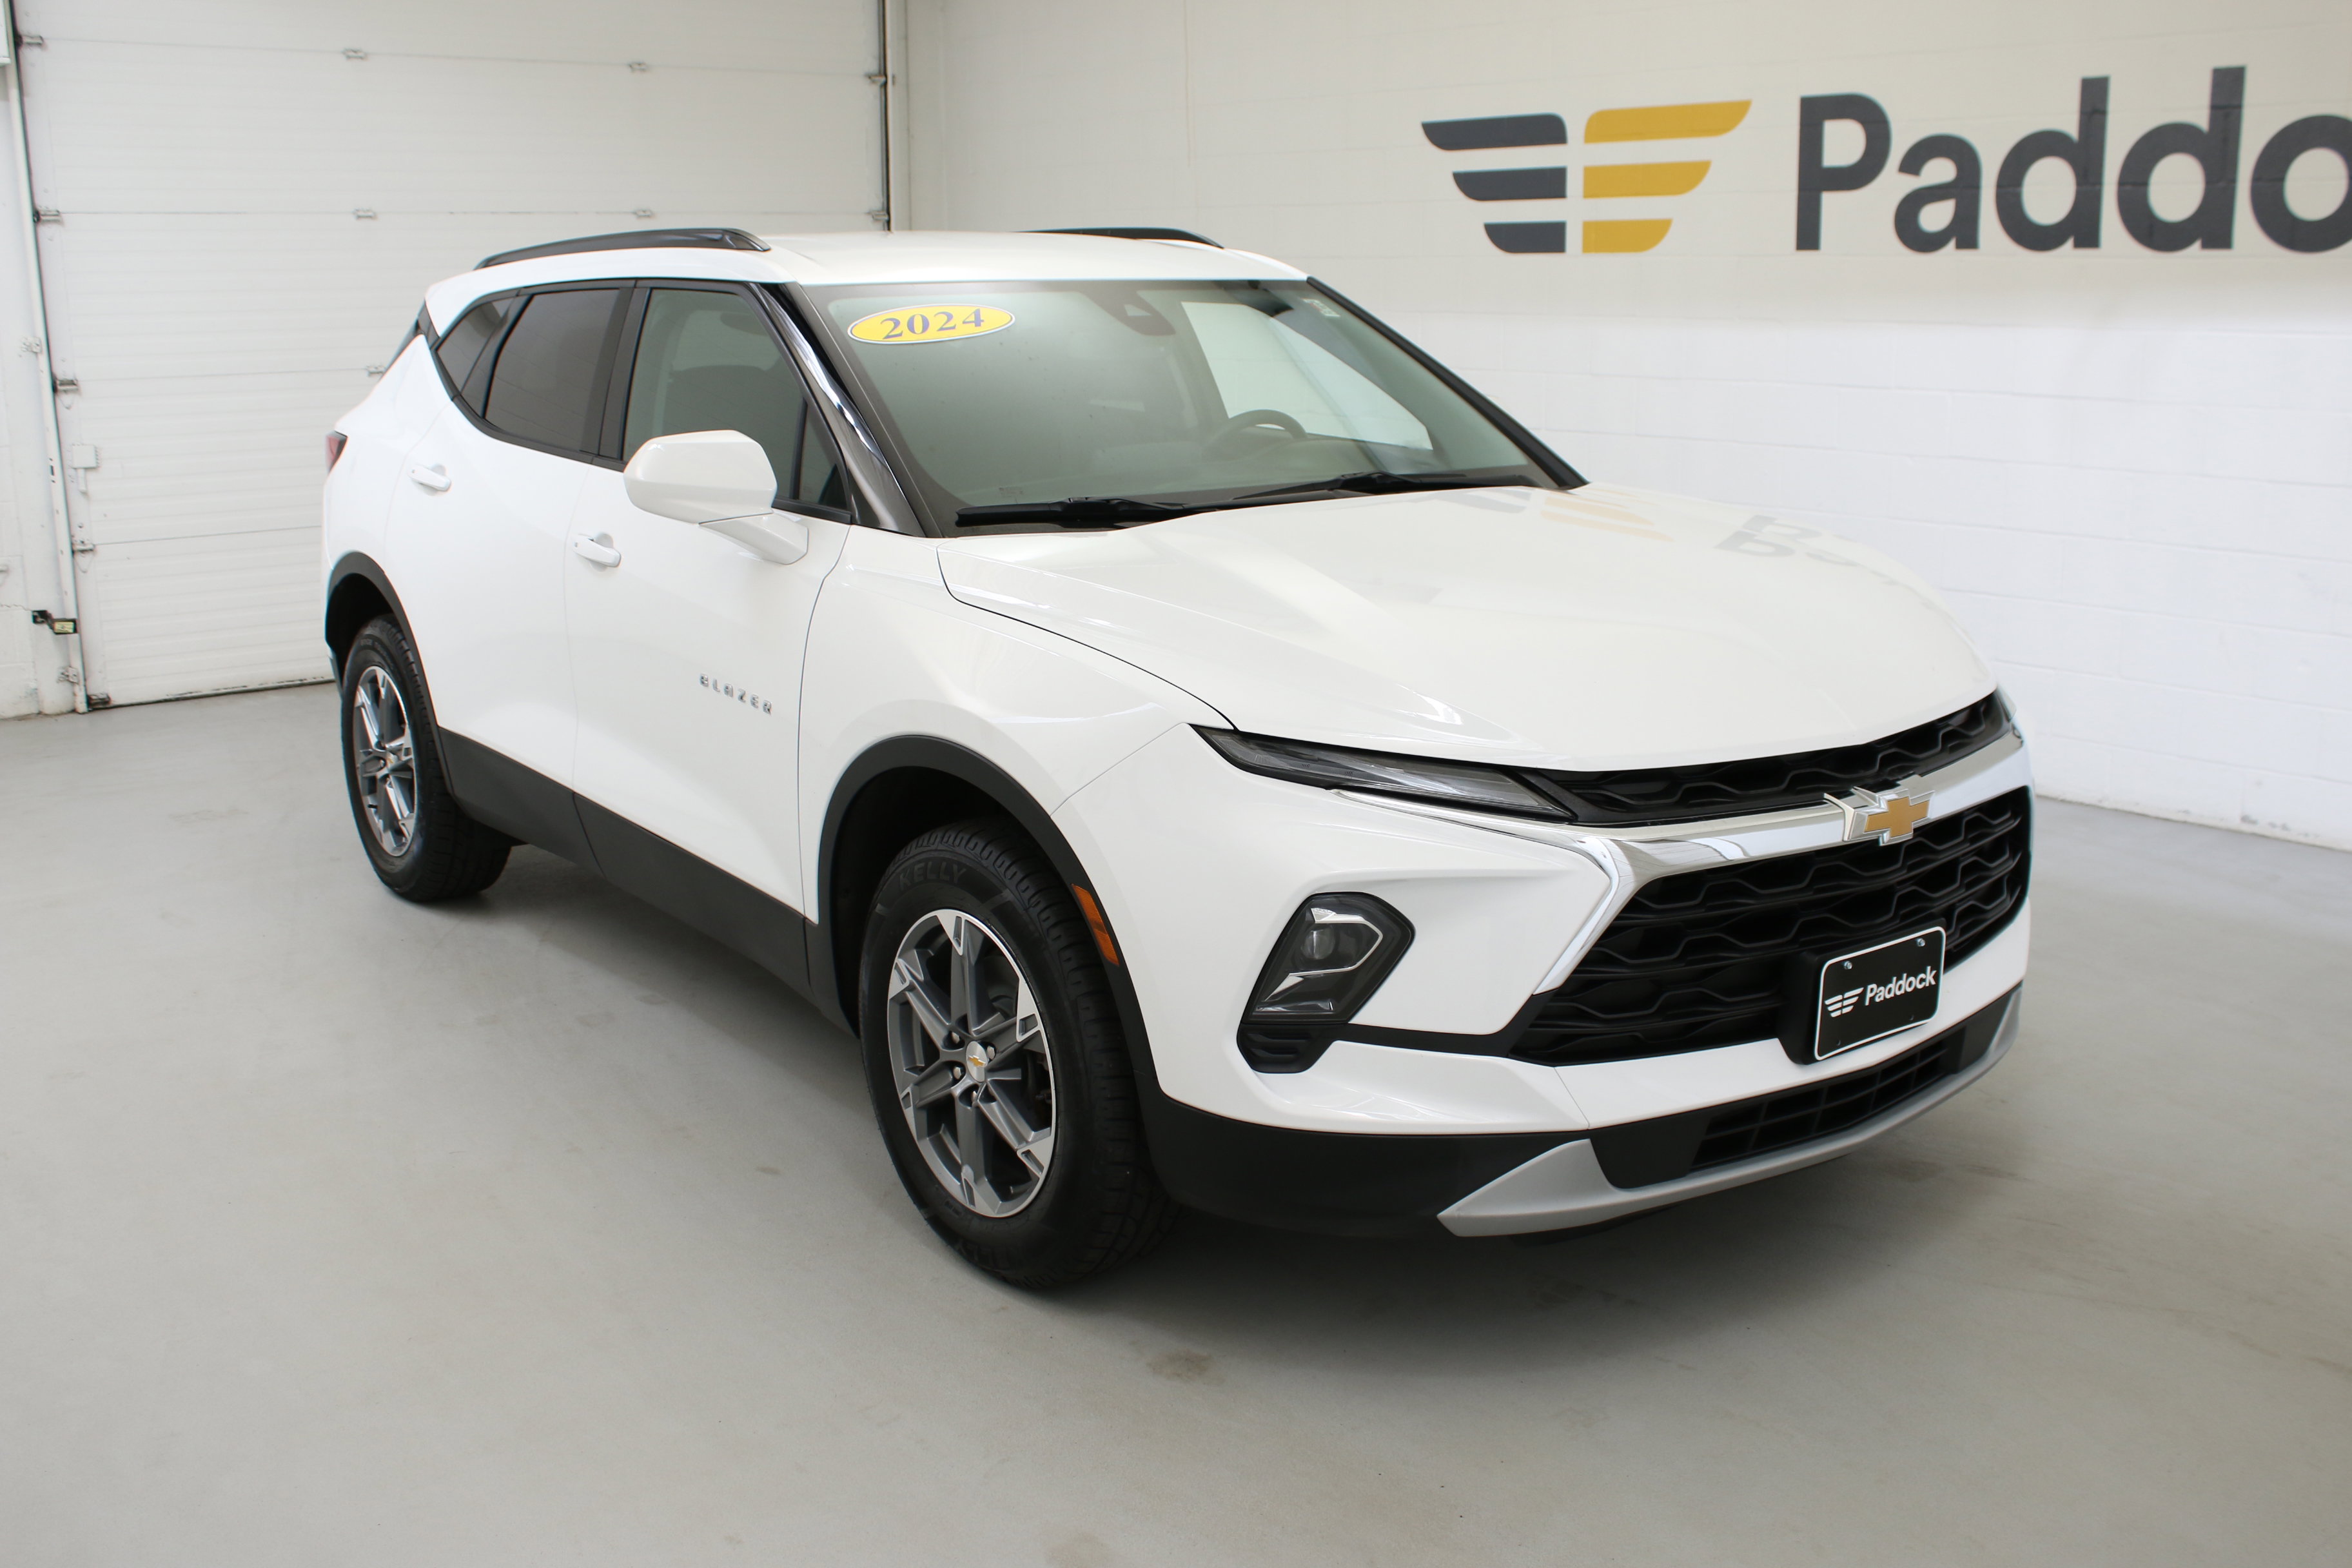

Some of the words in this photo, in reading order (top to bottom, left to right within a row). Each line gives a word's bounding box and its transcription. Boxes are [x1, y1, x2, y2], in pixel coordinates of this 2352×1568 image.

[880, 308, 985, 340] 2024
[700, 673, 772, 715] BLAZER
[899, 861, 966, 890] KELLY
[1865, 966, 1937, 1006] Paddock
